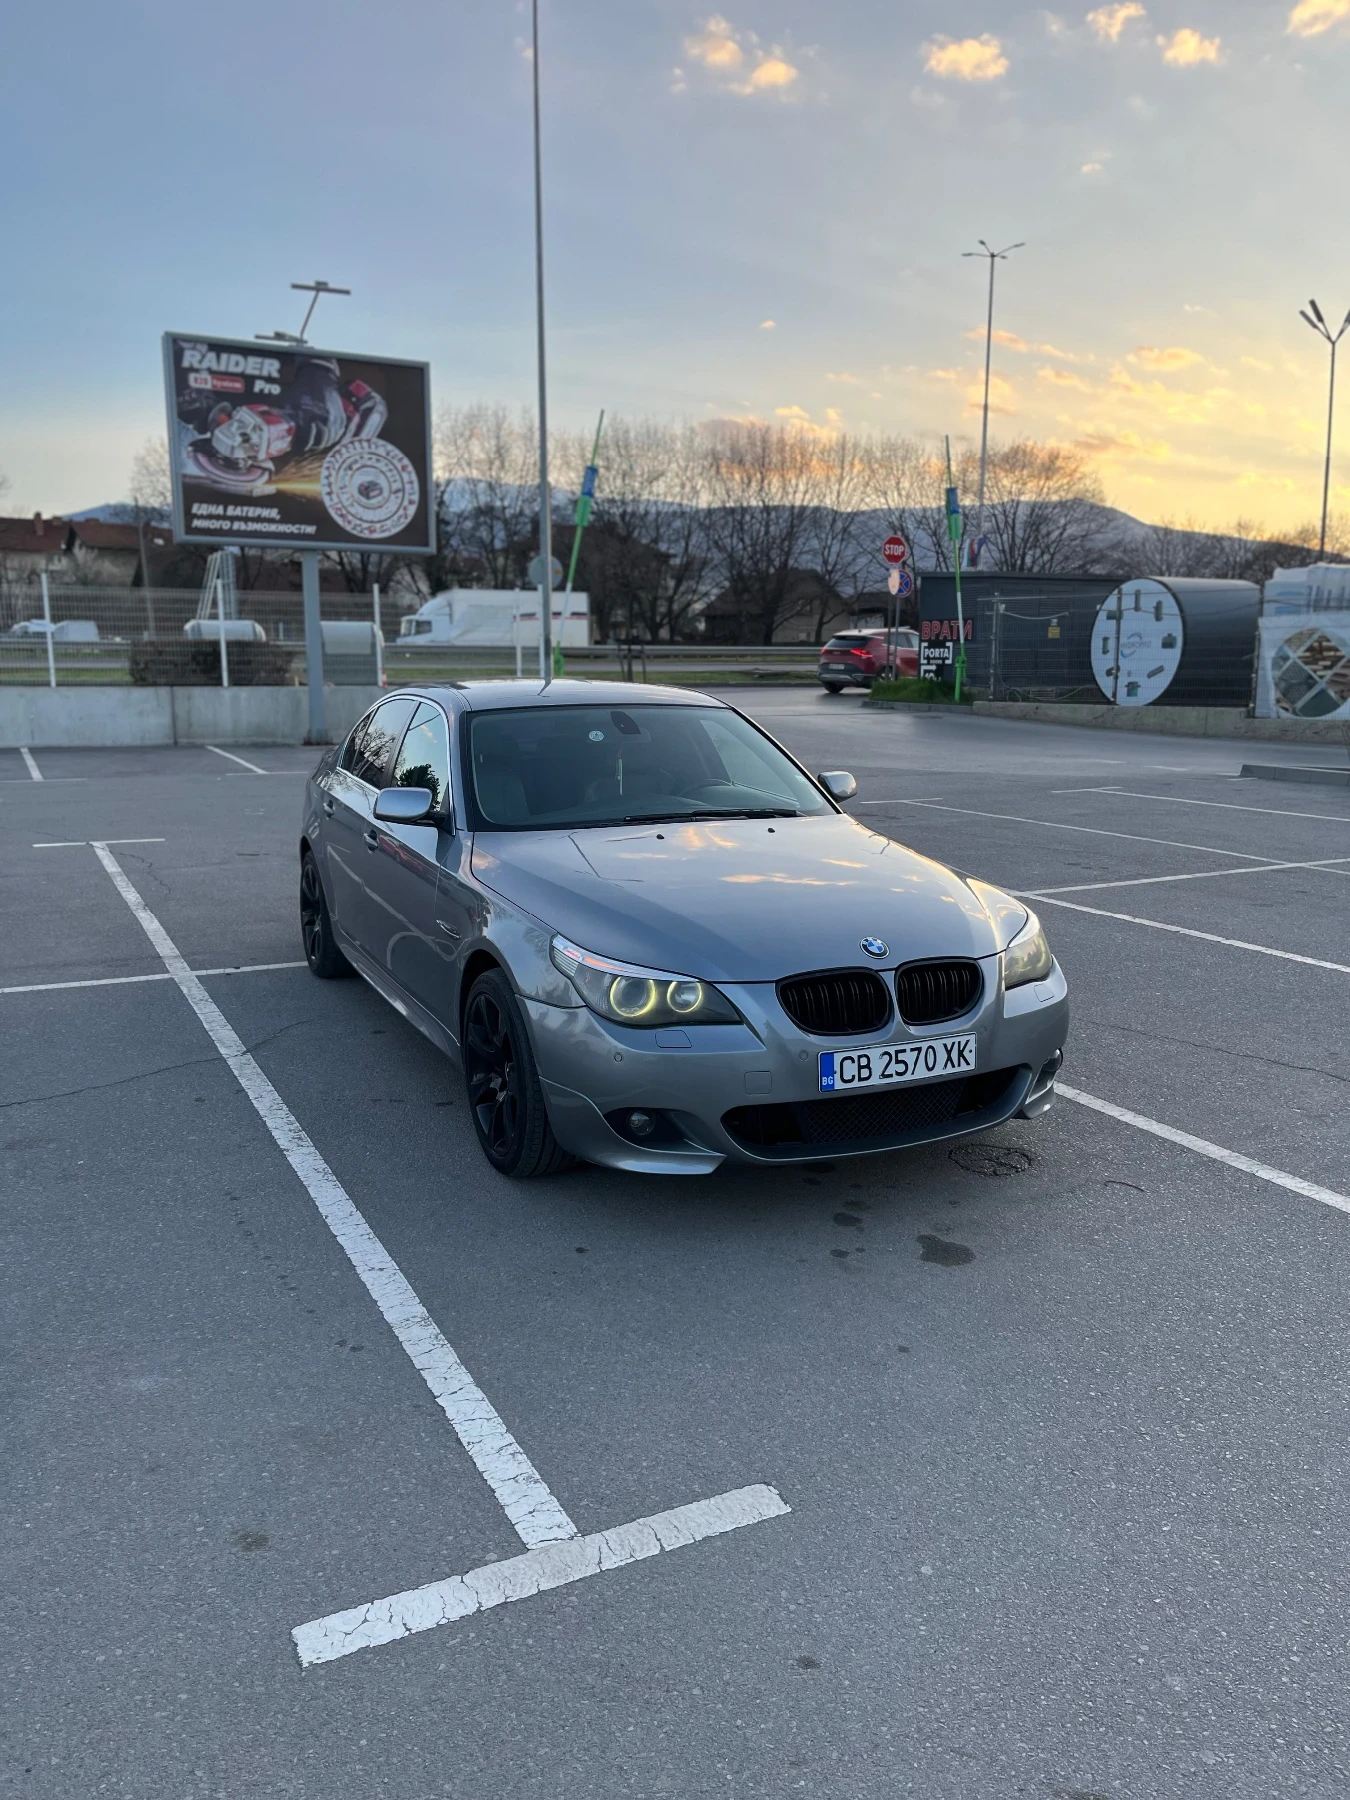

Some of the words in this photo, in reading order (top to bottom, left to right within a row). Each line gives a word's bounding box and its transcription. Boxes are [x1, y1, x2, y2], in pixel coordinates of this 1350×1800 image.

[181, 349, 280, 378] RAIDER
[253, 379, 281, 394] Pro
[191, 502, 224, 515] ЕДНА
[226, 505, 281, 520] БАТЕРИЯ,
[191, 518, 231, 530] МНОГО
[232, 520, 317, 535] ВЪЗМОЖНОСТИ!
[885, 544, 904, 555] STOP
[921, 619, 972, 640] ВРАТИ
[924, 648, 949, 658] PORTA
[839, 1054, 872, 1083] CB
[879, 1045, 937, 1079] 2570
[942, 1039, 971, 1070] XK
[822, 1076, 833, 1086] BG
